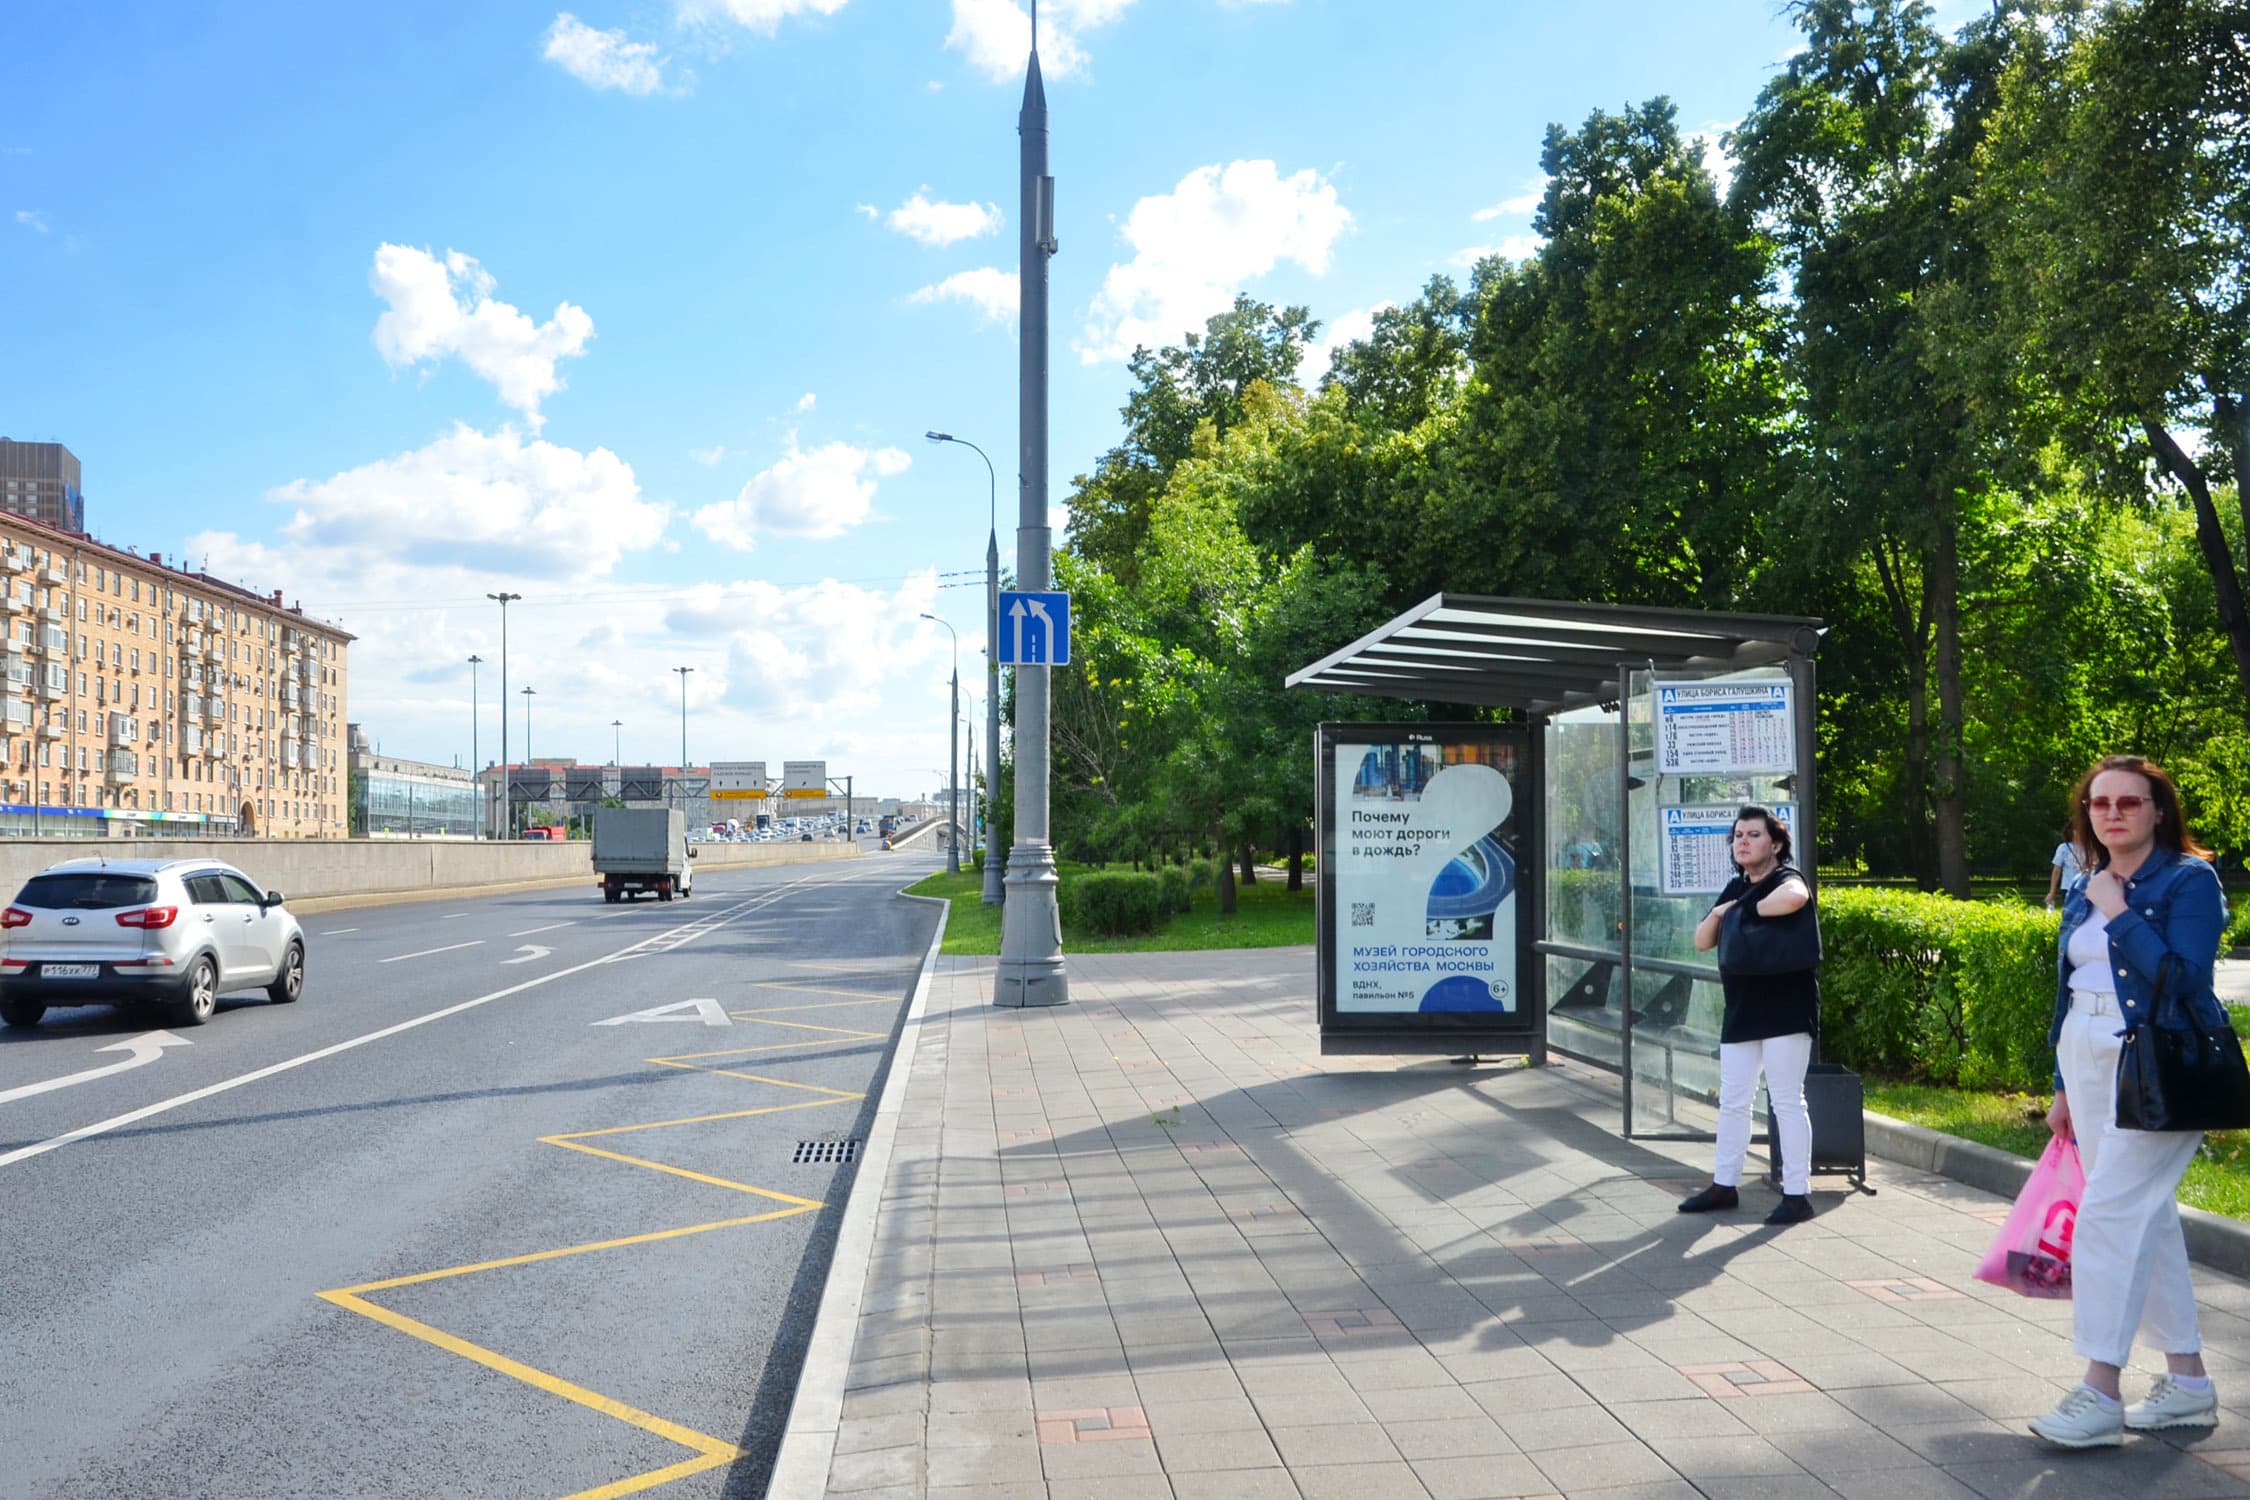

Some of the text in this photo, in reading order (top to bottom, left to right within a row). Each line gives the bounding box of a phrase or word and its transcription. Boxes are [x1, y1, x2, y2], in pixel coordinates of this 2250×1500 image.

[1677, 688, 1699, 698] УЛИЦА
[1700, 687, 1727, 697] БОРИСА
[1728, 686, 1769, 696] ГАЛУШКИНА
[1352, 811, 1410, 825] Почему
[1683, 809, 1705, 819] УЛИЦА
[1706, 809, 1732, 818] БОРИСА
[1352, 830, 1450, 842] моют дороги
[1352, 844, 1421, 858] в дождь?
[1353, 945, 1489, 958] МУЗЕЙ ГОРОДСКОГО
[1353, 960, 1494, 972] ХОЗЯЙСТВА МОСКВЫ
[1353, 980, 1382, 990] ВДНХ,
[1492, 984, 1506, 994] 6+
[1397, 991, 1415, 999] №5
